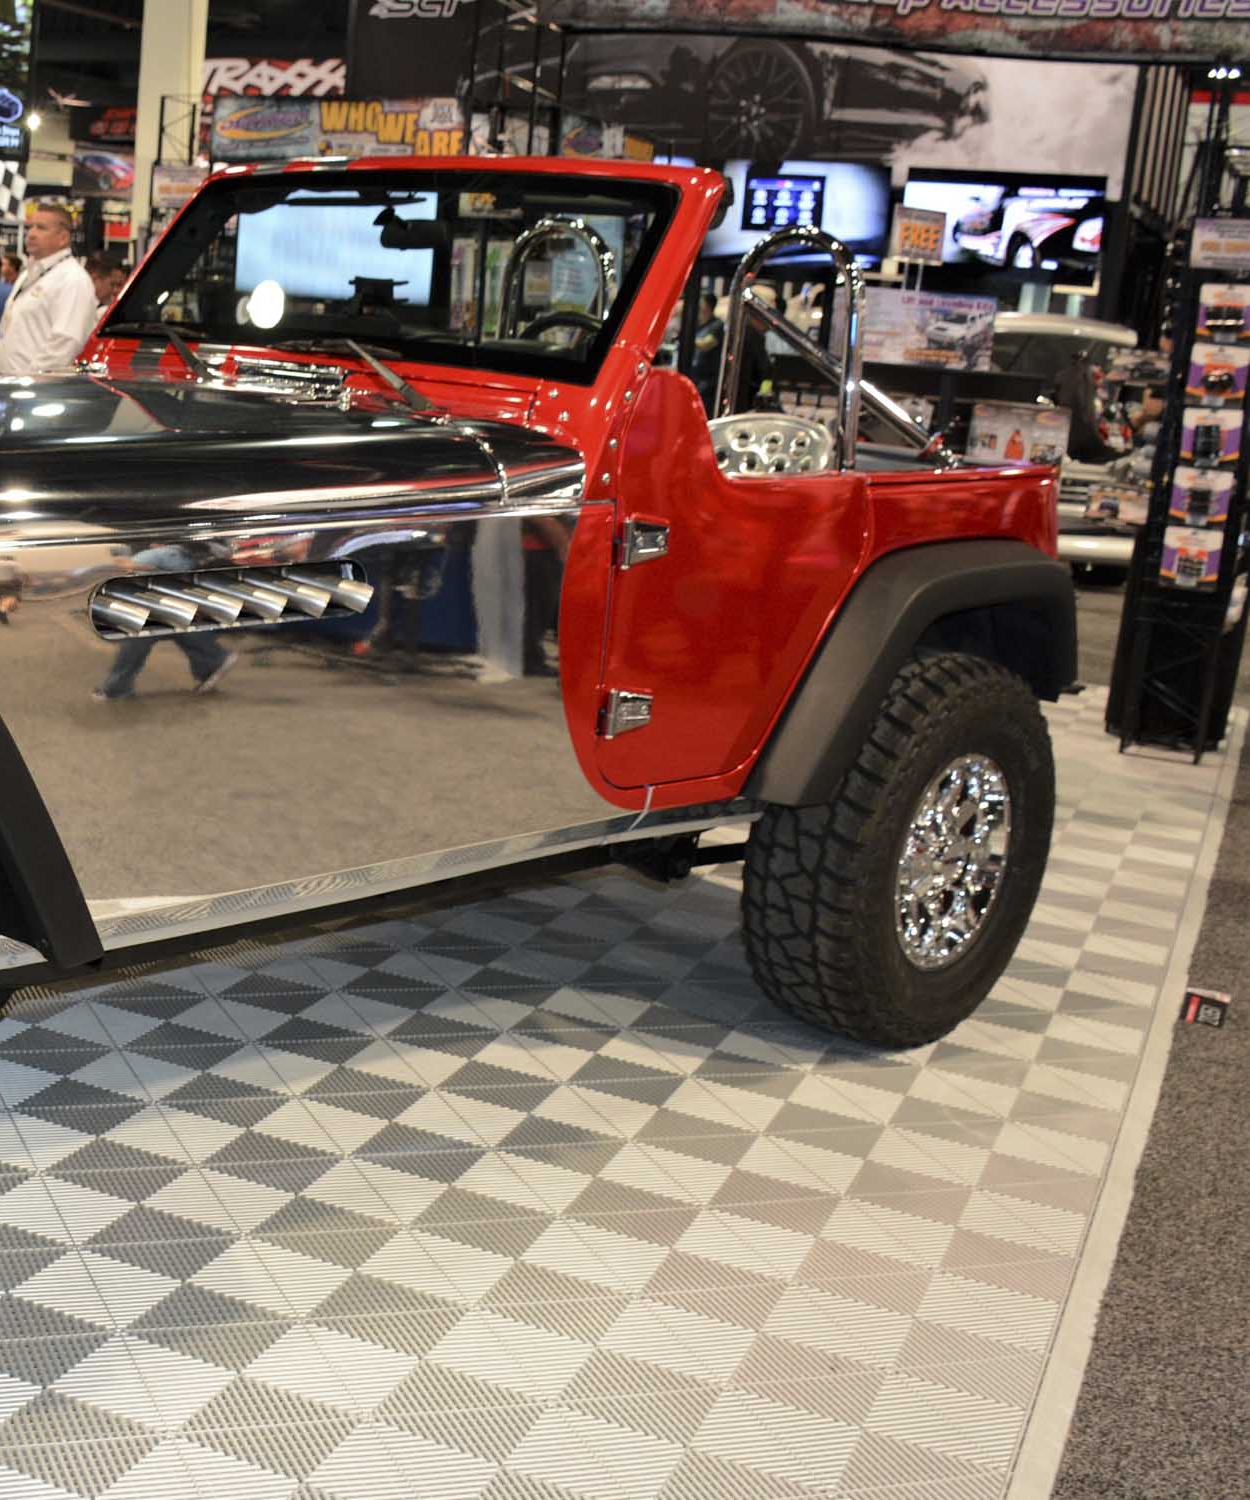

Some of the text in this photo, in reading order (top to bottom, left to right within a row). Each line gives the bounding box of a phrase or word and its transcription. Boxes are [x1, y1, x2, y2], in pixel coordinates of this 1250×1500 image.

[321, 101, 383, 131] WHO
[377, 112, 419, 143] WE
[414, 130, 463, 156] ARE
[900, 223, 942, 251] FREE
